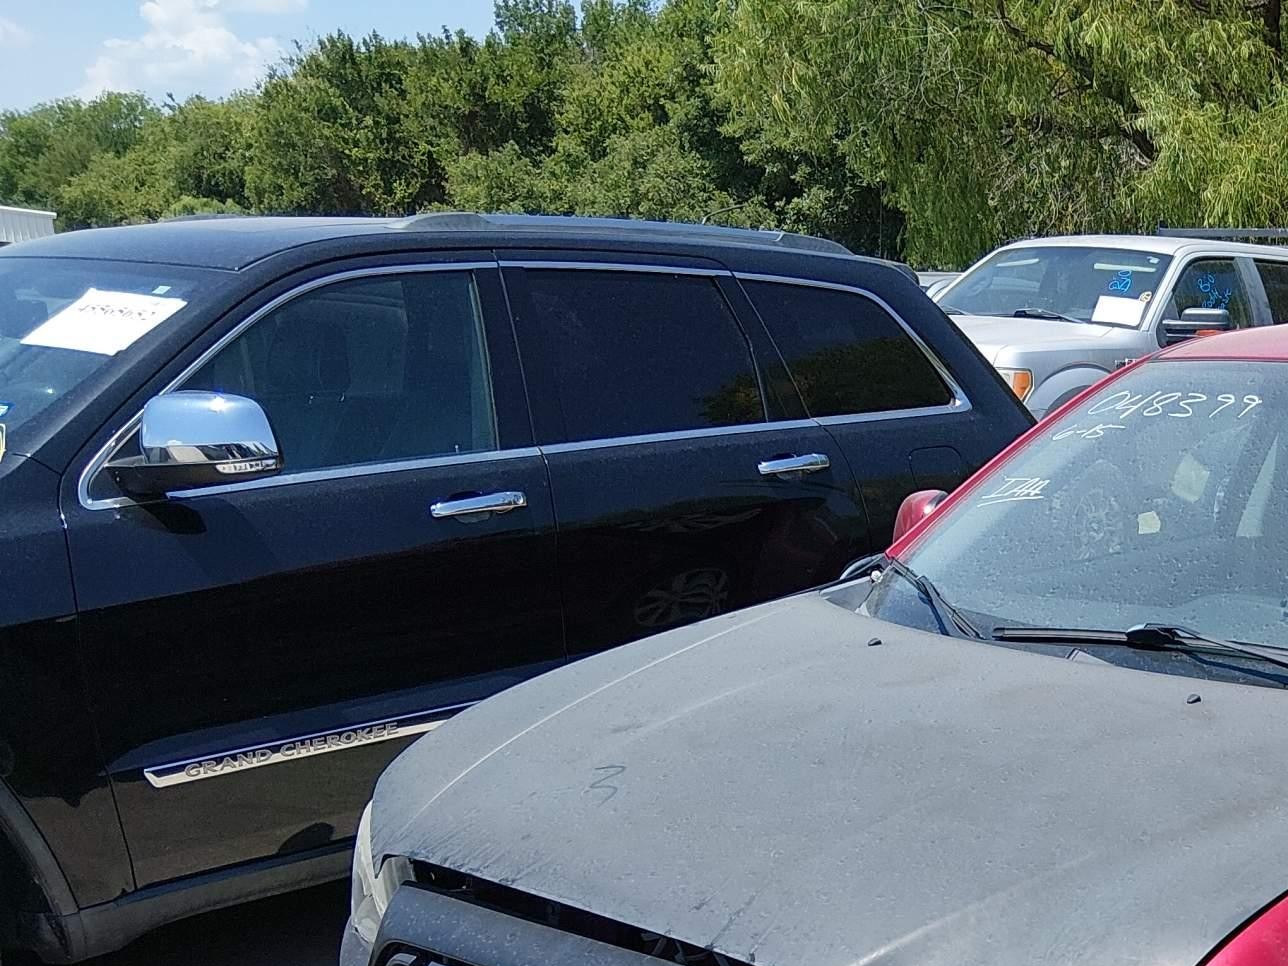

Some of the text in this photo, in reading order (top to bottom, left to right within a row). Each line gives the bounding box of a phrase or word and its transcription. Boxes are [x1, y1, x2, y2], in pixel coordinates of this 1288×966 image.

[1088, 390, 1263, 419] 048399
[185, 721, 400, 778] GRAND CHEROKEE
